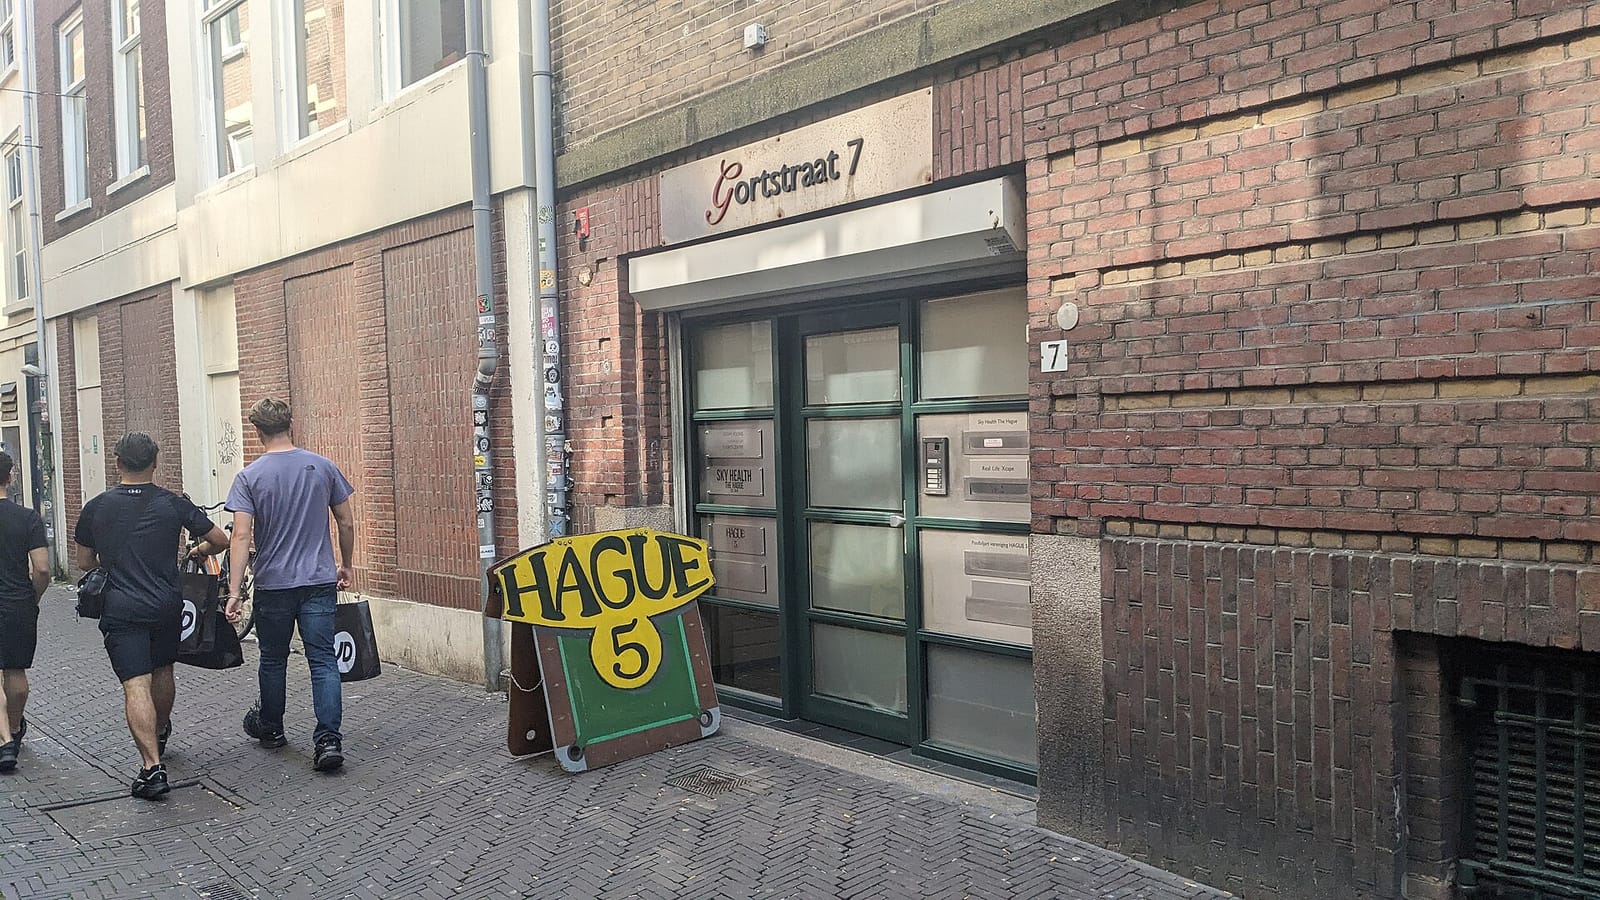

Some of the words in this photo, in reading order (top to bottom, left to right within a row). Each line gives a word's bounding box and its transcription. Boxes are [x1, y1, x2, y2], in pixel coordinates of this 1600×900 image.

[705, 149, 840, 225] Gortstraat
[846, 137, 864, 175] 7
[1048, 343, 1060, 370] 7
[716, 468, 728, 482] SKY
[729, 468, 752, 482] HEALTH
[726, 527, 745, 538] HAGUE
[500, 535, 710, 621] HAGUE
[335, 641, 353, 663] JD
[611, 618, 649, 680] 5
